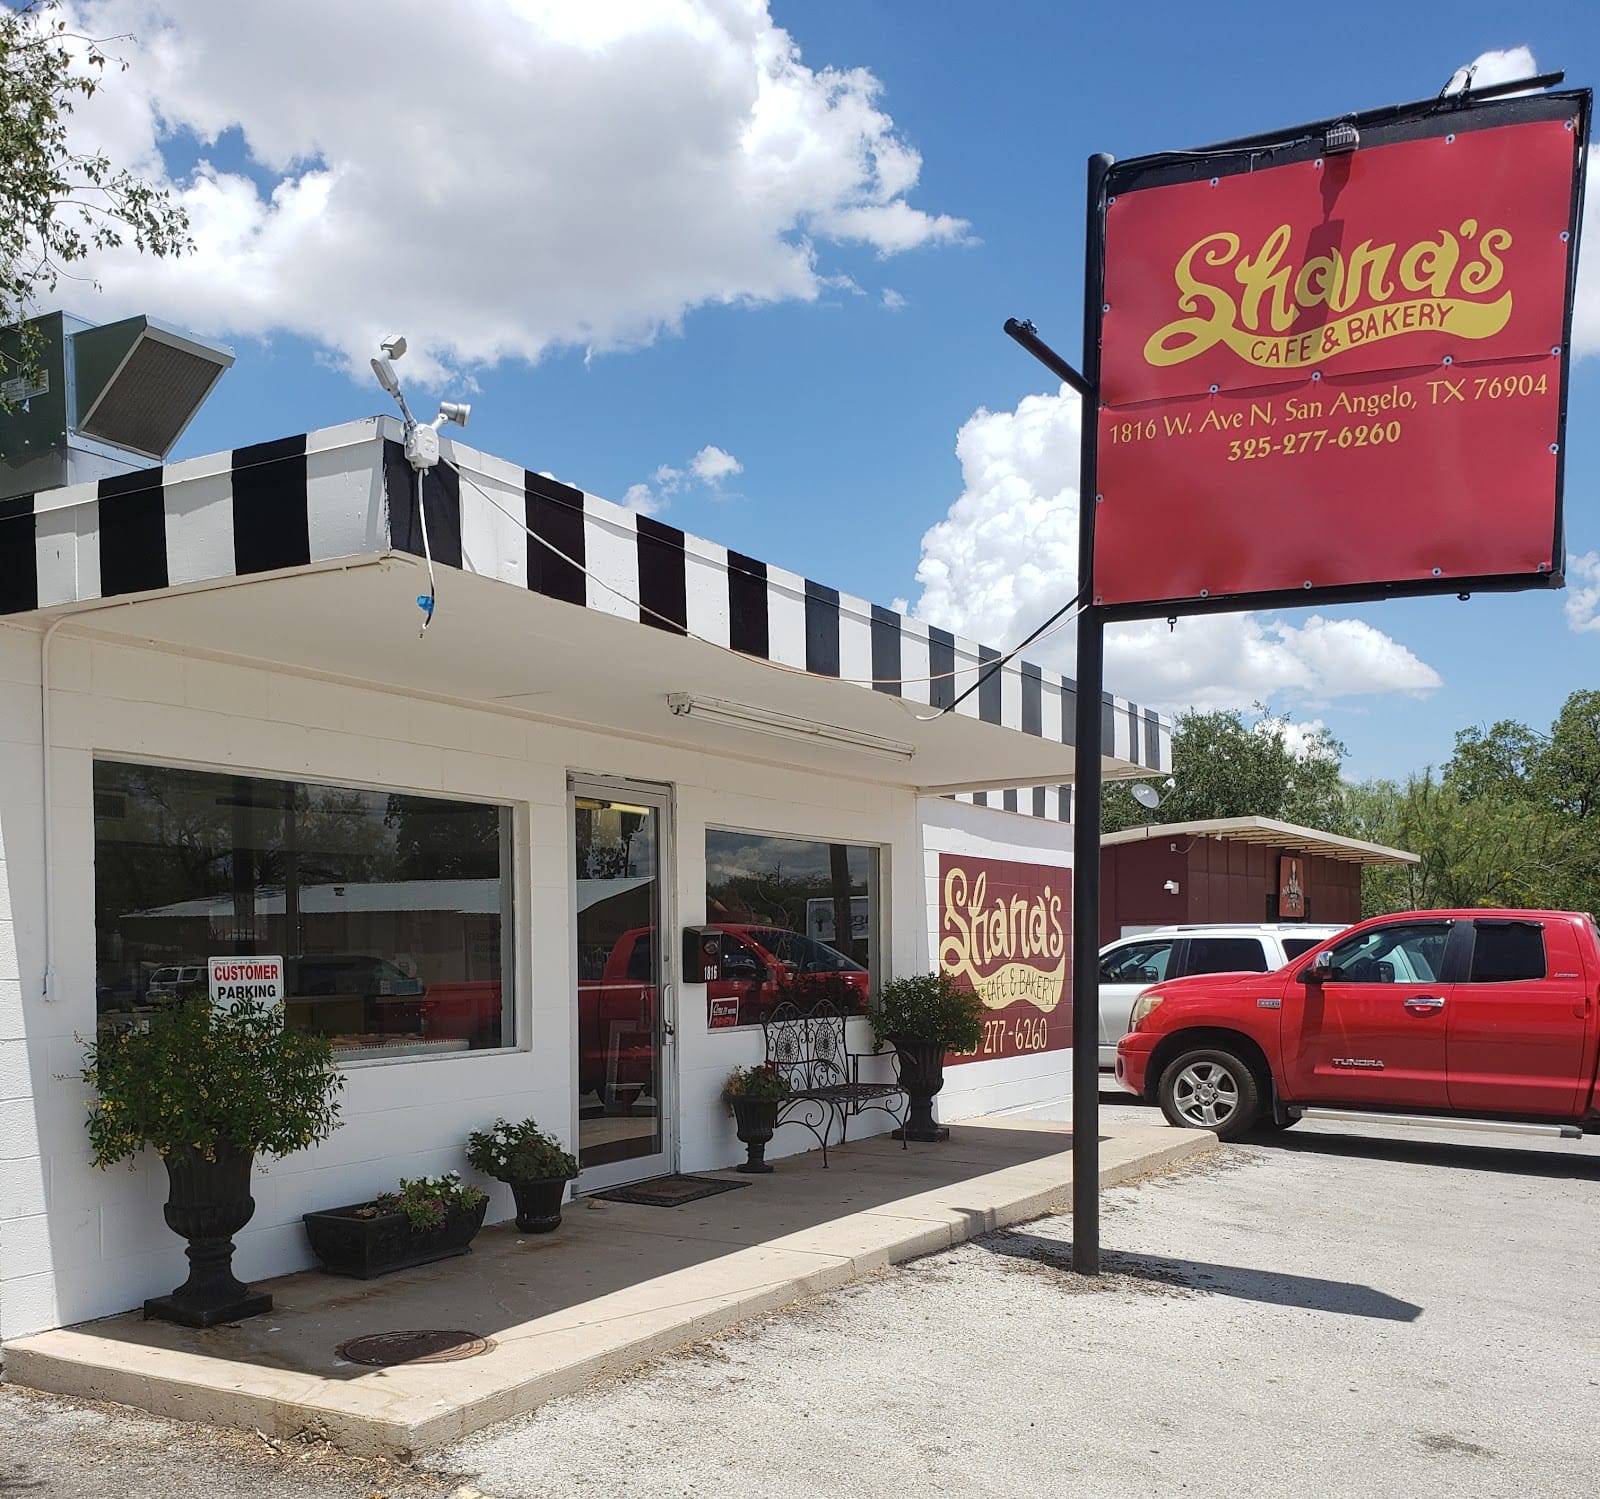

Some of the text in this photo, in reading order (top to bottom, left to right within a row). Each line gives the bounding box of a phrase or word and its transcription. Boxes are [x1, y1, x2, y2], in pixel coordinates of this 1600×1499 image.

[1143, 218, 1513, 366] Shana's
[1250, 302, 1454, 364] CAFE & BAKERY
[1109, 373, 1548, 445] 1816 W. Ave N, San Angelo, TX 76904
[1227, 420, 1401, 462] 325-277-6260
[940, 867, 1064, 977] Shana's
[214, 964, 278, 981] CUSTOMER
[217, 984, 276, 1000] PARKING
[704, 964, 718, 981] 1816
[987, 968, 1057, 1006] CAFE & BAKERY
[1332, 1057, 1385, 1068] TUNDRA
